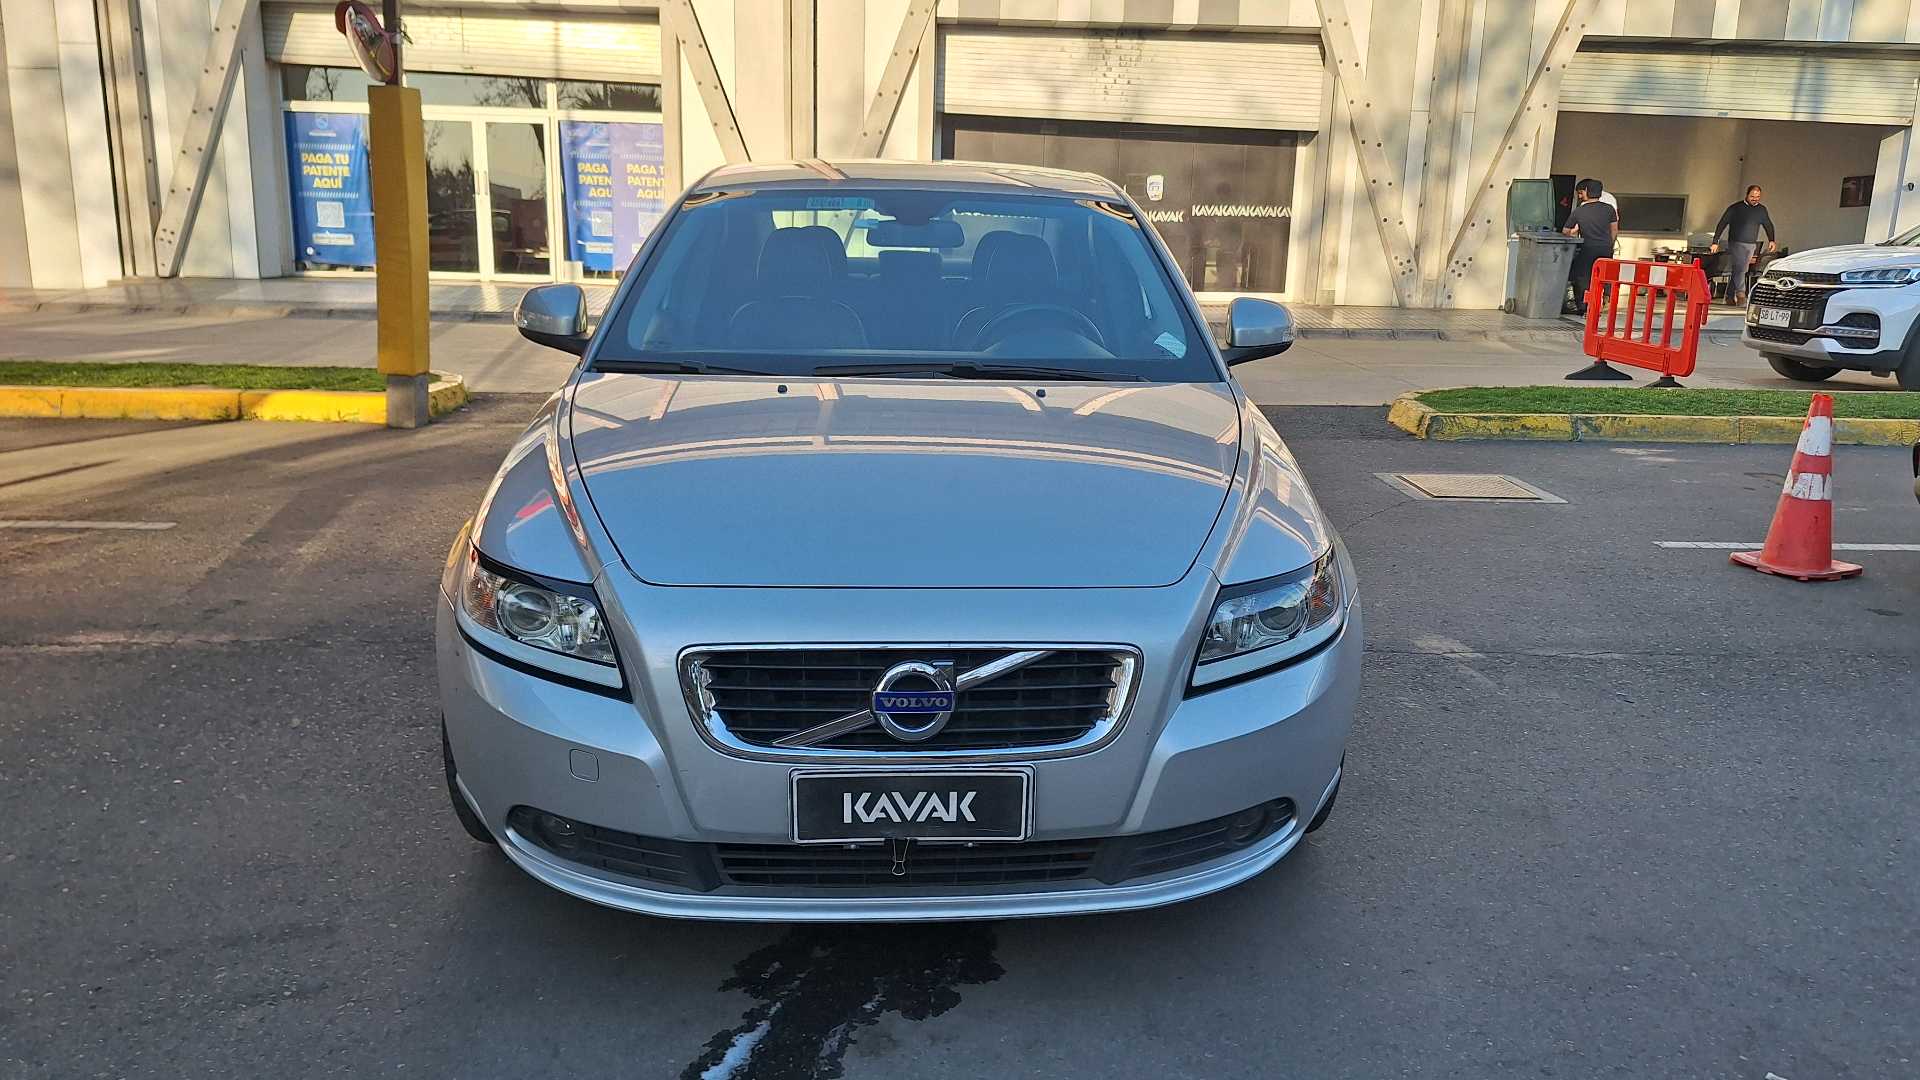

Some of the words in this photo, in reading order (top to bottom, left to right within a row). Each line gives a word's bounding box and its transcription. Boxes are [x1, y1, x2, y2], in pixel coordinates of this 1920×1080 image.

[302, 153, 333, 164] PAGA
[335, 153, 350, 165] TU
[303, 165, 351, 177] PATENTE
[577, 162, 609, 174] PAGA
[626, 163, 657, 175] PAGA
[879, 697, 948, 708] VOLVO
[843, 791, 977, 824] KAVAK
